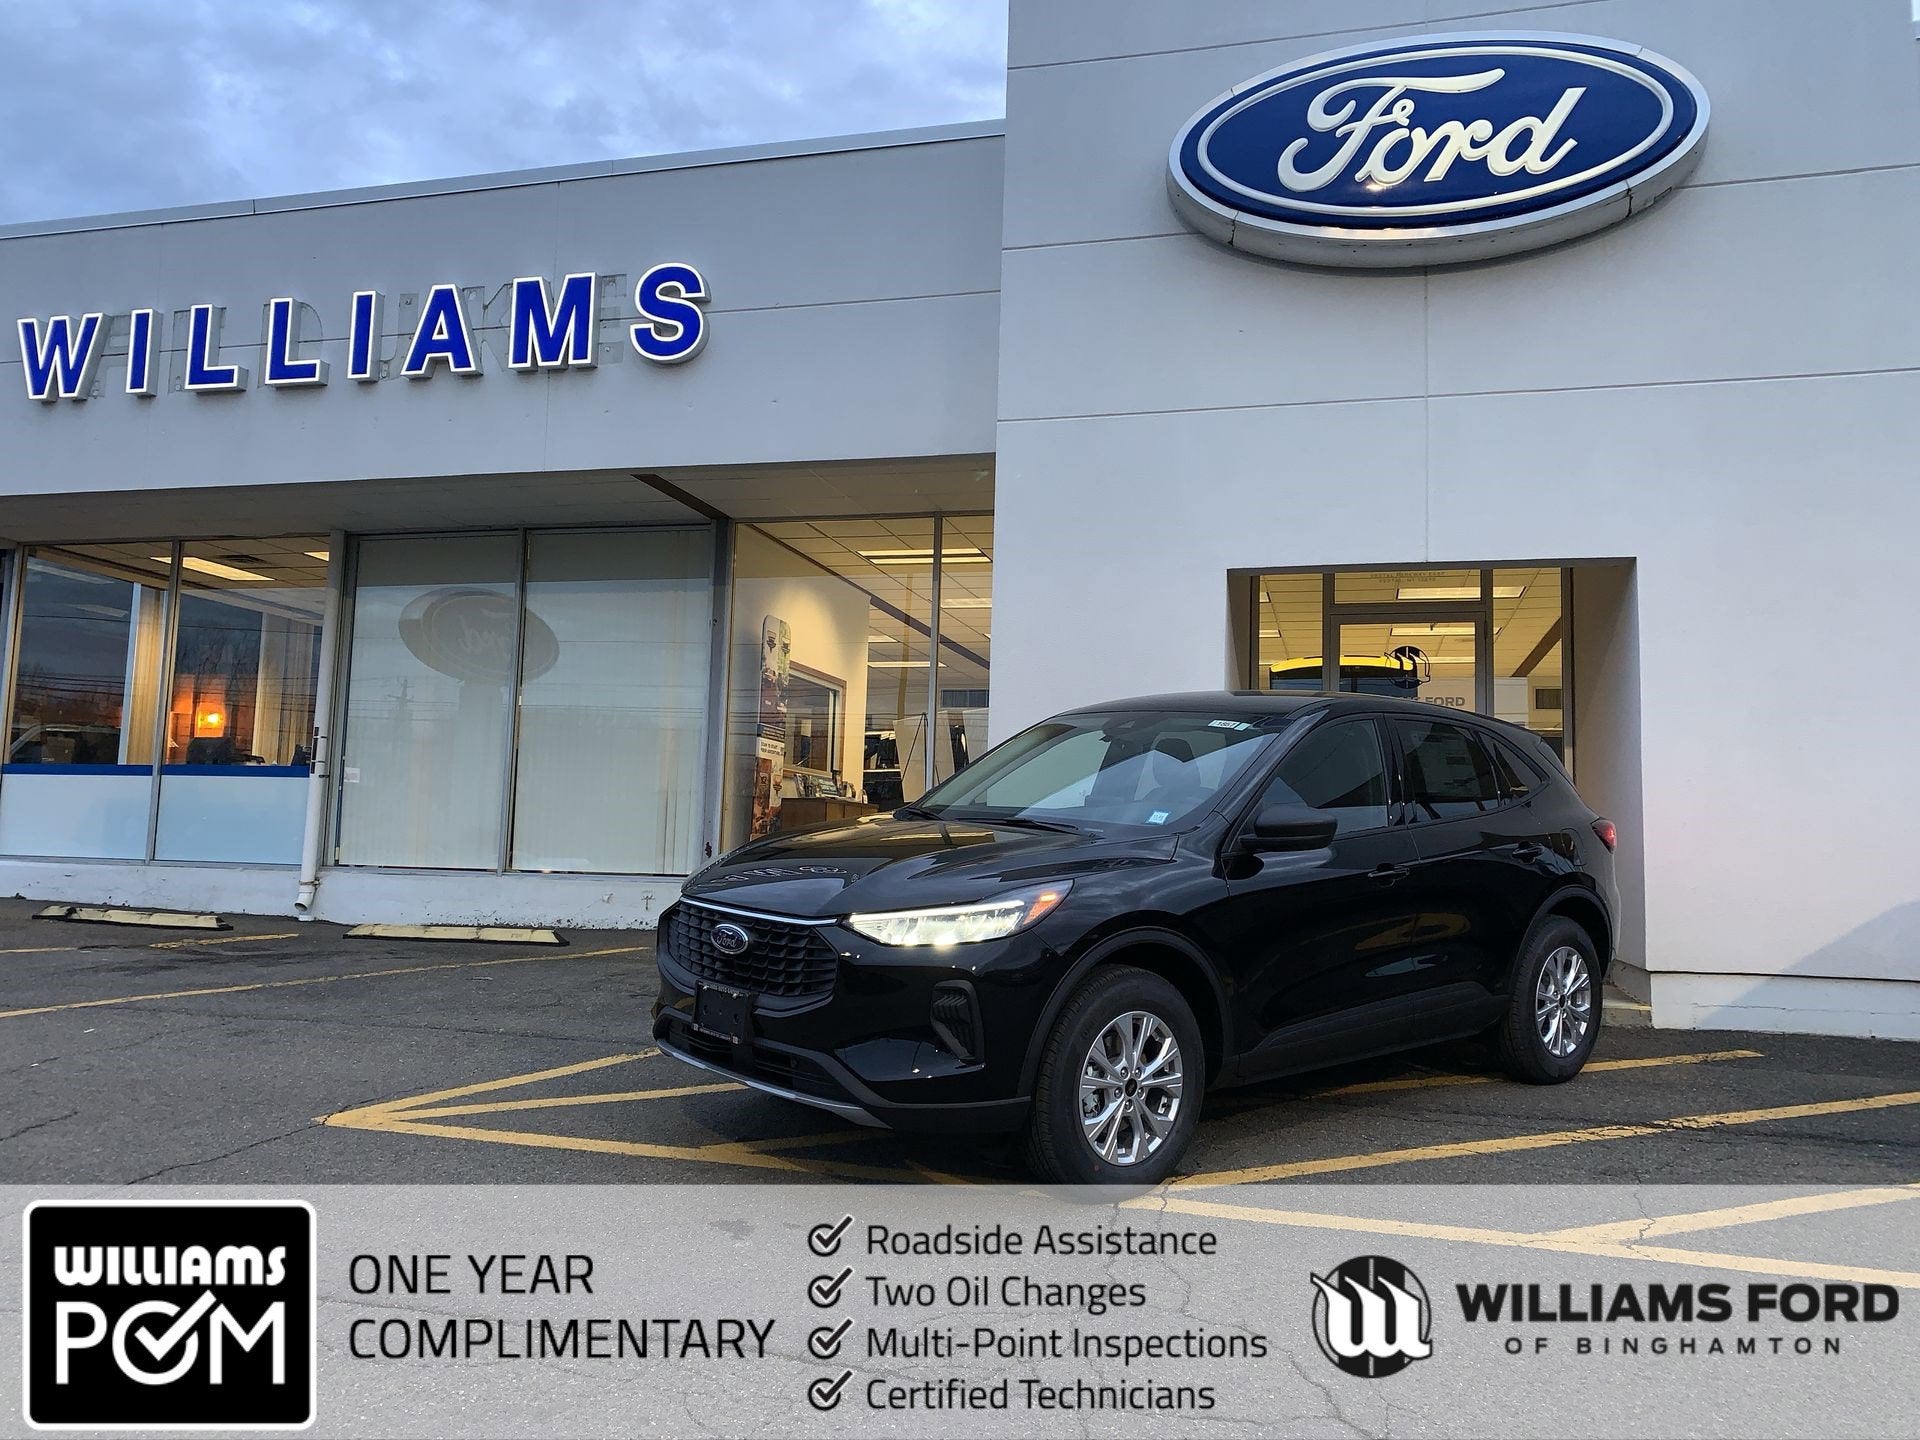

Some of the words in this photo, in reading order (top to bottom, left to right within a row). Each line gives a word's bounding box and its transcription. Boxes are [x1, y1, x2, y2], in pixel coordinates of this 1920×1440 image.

[1277, 68, 1587, 193] Ford
[17, 262, 711, 401] WILLIAMS
[1425, 696, 1466, 707] FORD
